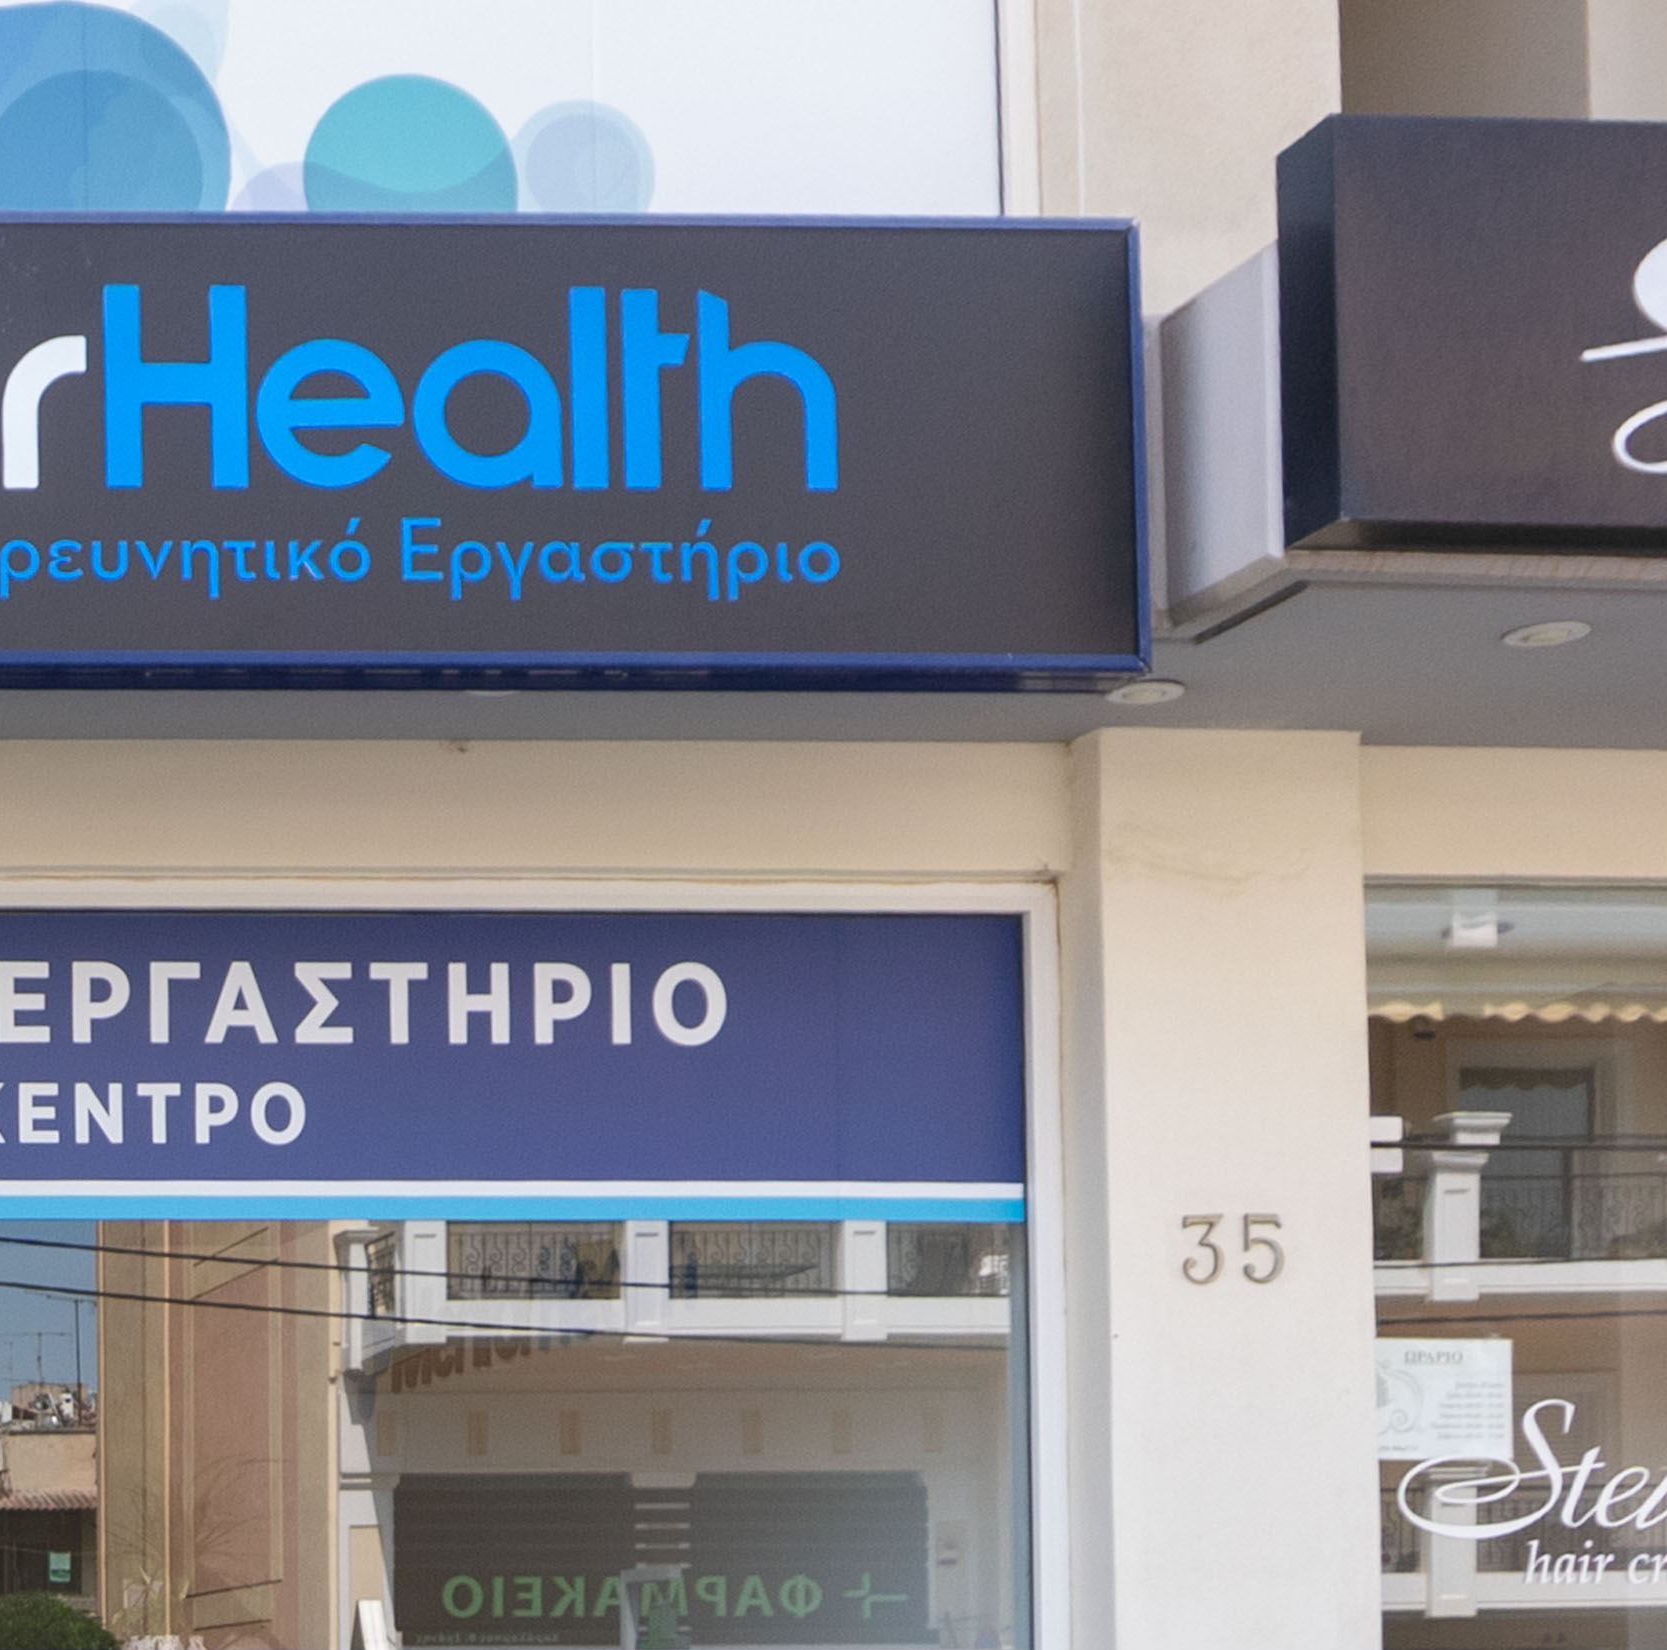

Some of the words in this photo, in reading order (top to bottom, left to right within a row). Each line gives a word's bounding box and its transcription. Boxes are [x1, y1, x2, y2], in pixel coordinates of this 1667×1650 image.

[400, 517, 841, 601] Εργαστήριο
[1180, 1212, 1286, 1285] 35
[1525, 1539, 1616, 1585] hair
